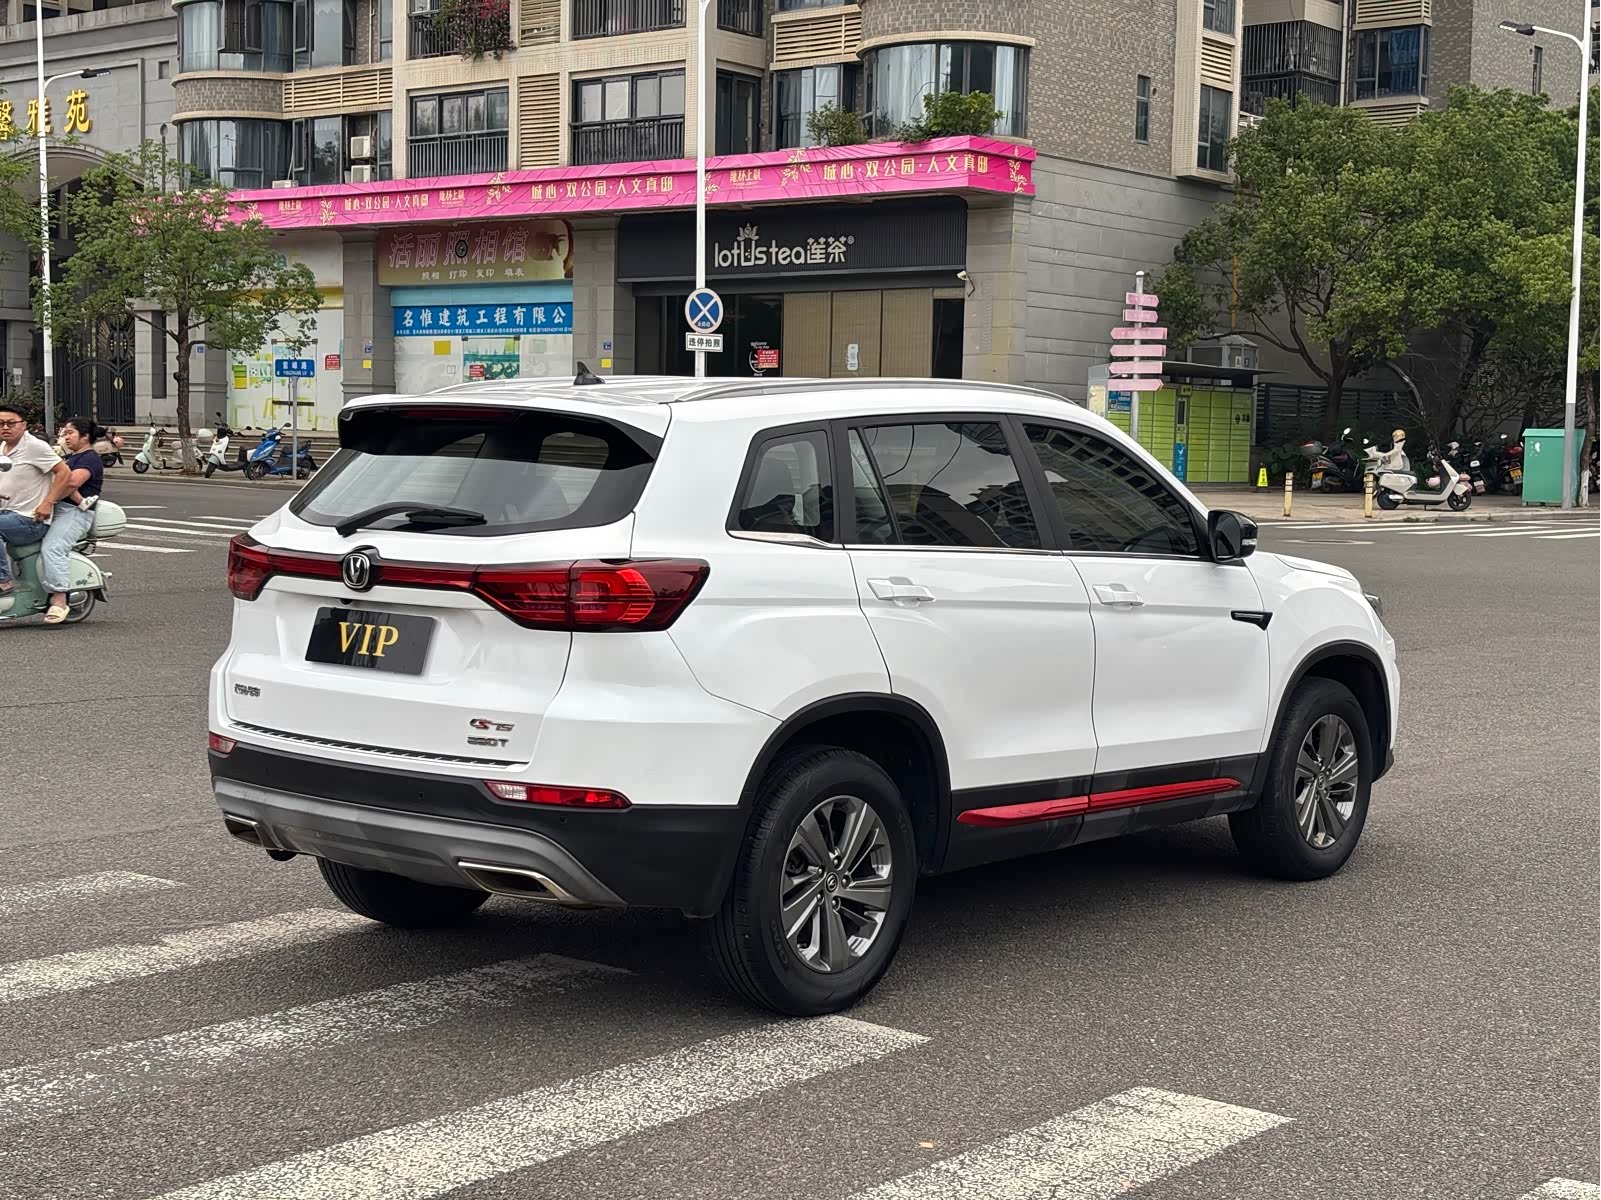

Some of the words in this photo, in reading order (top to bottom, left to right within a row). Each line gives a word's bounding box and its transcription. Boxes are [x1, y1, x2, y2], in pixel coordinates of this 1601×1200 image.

[389, 227, 529, 269] 活丽照相馆
[449, 269, 468, 280] 打印
[476, 268, 495, 279] 复印
[338, 621, 399, 657] VIP
